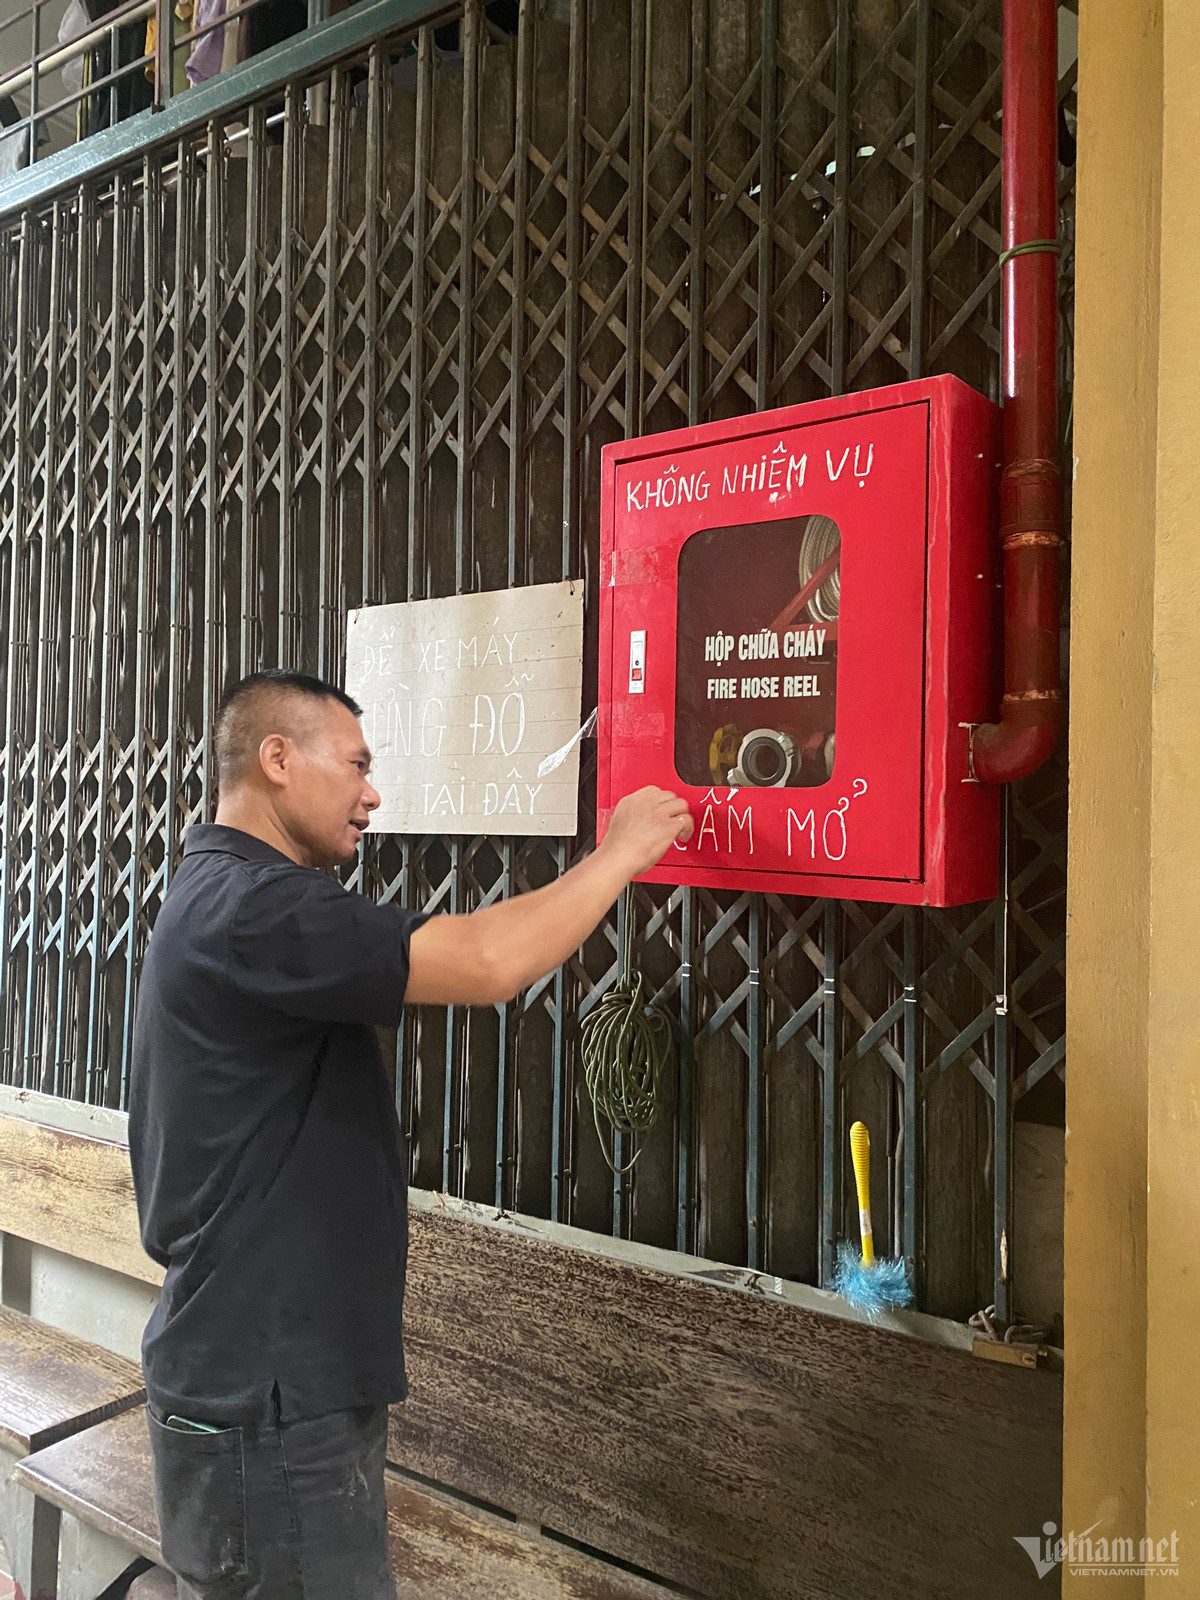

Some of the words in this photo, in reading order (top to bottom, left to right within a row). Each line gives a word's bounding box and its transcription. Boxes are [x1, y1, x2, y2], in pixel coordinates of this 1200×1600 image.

[626, 463, 711, 513] KHÔNG
[825, 443, 874, 489] VỤ
[361, 625, 394, 677] ĐỂ
[417, 639, 447, 673] XE
[457, 616, 518, 668] MÁY
[704, 630, 735, 666] HỘP
[737, 628, 780, 661] CHỮA
[782, 624, 827, 658] CHÁY
[360, 682, 448, 758] ỪNG
[468, 672, 536, 757] ĐỖ
[706, 678, 737, 700] FIRE
[740, 676, 779, 699] HOSE
[783, 674, 821, 697] REEL
[421, 775, 465, 816] TẠI
[482, 766, 543, 816] ĐÂY
[787, 778, 868, 861] MỞ
